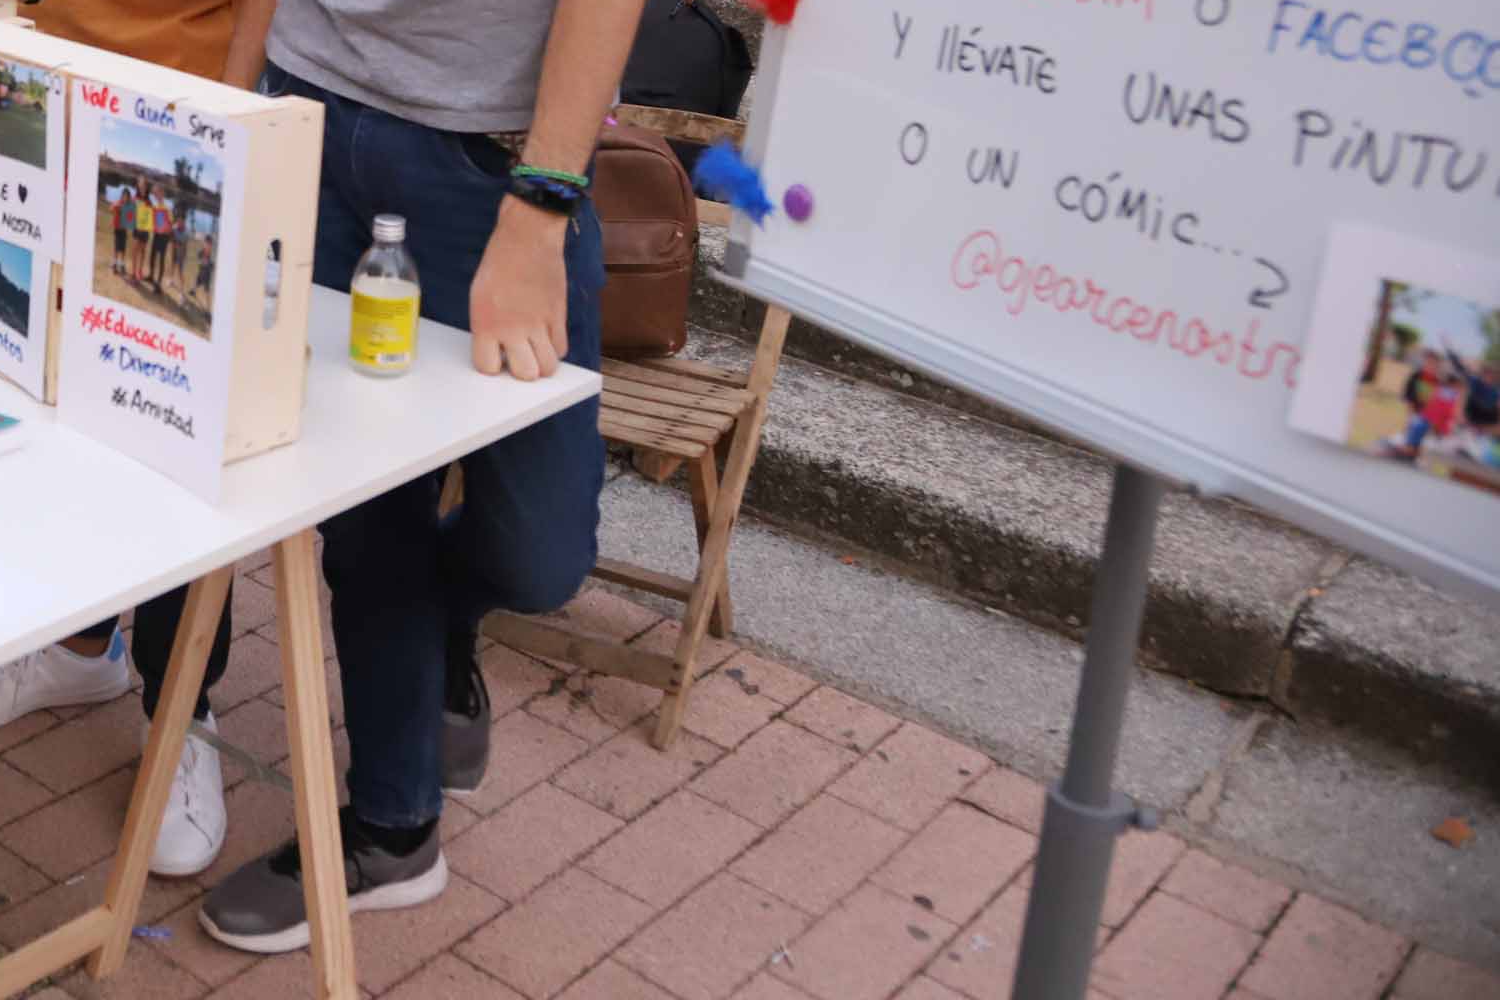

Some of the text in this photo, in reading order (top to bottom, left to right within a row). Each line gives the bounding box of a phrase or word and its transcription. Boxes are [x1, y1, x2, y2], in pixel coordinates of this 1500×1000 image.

[892, 9, 914, 60] Y
[1123, 70, 1251, 144] UNAS
[1293, 109, 1500, 197] PINTU
[899, 121, 929, 166] O
[965, 147, 1020, 189] UN
